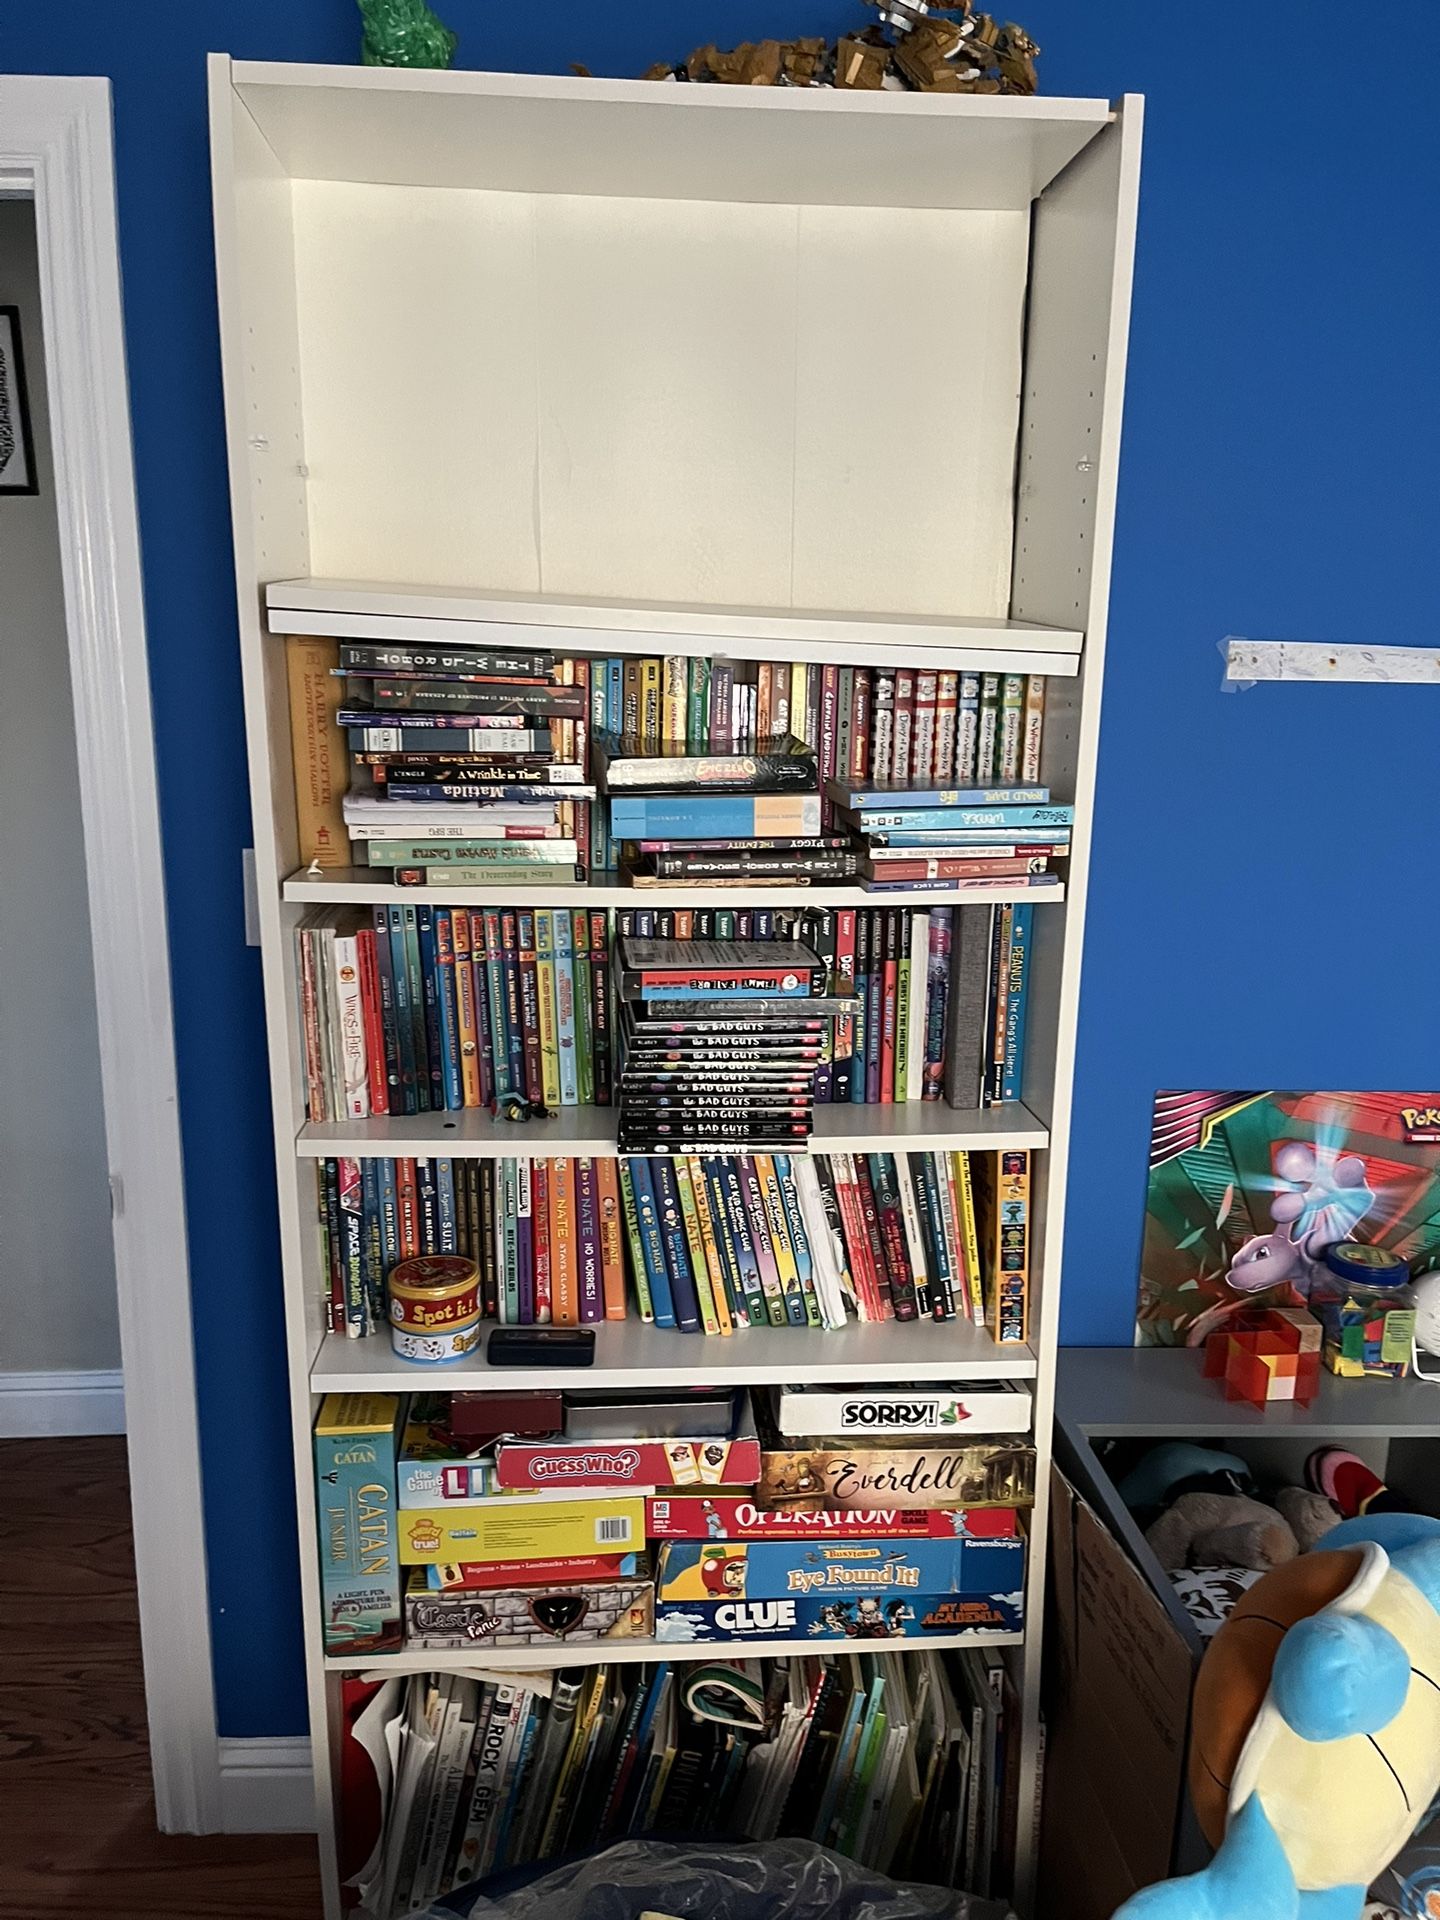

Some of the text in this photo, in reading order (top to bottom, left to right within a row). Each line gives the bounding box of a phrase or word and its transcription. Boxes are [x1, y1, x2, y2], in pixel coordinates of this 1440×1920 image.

[376, 654, 529, 670] THE WILD ROBOT
[824, 692, 834, 731] CAPTAIN
[458, 771, 465, 779] A
[466, 768, 505, 779] Wrinkle
[507, 771, 516, 779] in
[518, 769, 541, 779] Time
[443, 786, 505, 798] Matilda
[985, 791, 1043, 801] ROALD DAHL
[429, 828, 464, 836] THE BFG
[790, 839, 825, 848] PIGGY
[782, 861, 812, 870] WILD
[596, 970, 604, 987] RISE
[690, 978, 777, 990] TIMMY FAILURE
[597, 989, 605, 999] OF
[345, 994, 358, 1028] WINGS
[597, 1000, 605, 1015] THE
[1006, 946, 1023, 1077] PEANUTS The Gang's All Here!
[597, 1016, 605, 1029] CAT
[348, 1035, 361, 1058] FIRE
[731, 1038, 760, 1046] GUYS
[722, 1097, 750, 1106] GUYS
[698, 1124, 720, 1132] BAD
[722, 1124, 750, 1133] GUYS
[821, 1189, 835, 1213] WOLF
[916, 1174, 927, 1211] AMULET
[442, 1193, 452, 1251] Agents S.U.I.T.
[557, 1199, 568, 1238] NATE
[582, 1199, 593, 1236] NATE
[727, 1174, 750, 1252] CAT KID COMIC CLUB
[748, 1177, 771, 1254] CAT KID COMIC CLUB
[766, 1175, 789, 1253] CAT KID COMIC CLUB
[782, 1176, 806, 1254] CAT KID COMIC CLUB
[384, 1203, 395, 1251] MAX MEOW
[713, 1177, 726, 1219] HANDBOOK
[725, 1239, 735, 1263] GALAR
[730, 1265, 742, 1292] REGION
[508, 1229, 516, 1265] BITE-SIZE
[584, 1243, 593, 1255] NO
[609, 1221, 619, 1265] BIG NATE
[649, 1230, 663, 1274] BIG NATE
[674, 1233, 684, 1251] BIG
[348, 1216, 362, 1306] SPACE DUMPLINS
[559, 1243, 567, 1269] STAYS
[677, 1252, 687, 1278] NATE
[508, 1267, 516, 1292] BUILDS
[585, 1259, 595, 1300] WORRIES!
[413, 1299, 473, 1327] Spot it!
[845, 1404, 934, 1424] SORRY!
[335, 1452, 376, 1464] CATAN
[407, 1475, 444, 1492] Game
[415, 1469, 432, 1479] the
[826, 1456, 964, 1498] Everdell
[328, 1506, 347, 1560] JUNIOR
[357, 1484, 390, 1576] CATAN
[414, 1541, 439, 1549] true!
[829, 1550, 877, 1558] Busytown
[965, 1539, 1022, 1549] Ravensburger
[525, 1560, 563, 1569] Landmarks
[568, 1558, 597, 1567] Industry
[788, 1565, 919, 1593] Eye Found It!
[416, 1603, 483, 1628] Castle
[715, 1601, 796, 1629] CLUE
[921, 1610, 1004, 1624] ACADEMIA
[939, 1602, 989, 1611] MY HERO
[467, 1617, 501, 1639] Panic
[470, 1723, 504, 1823] ROCK GEM
